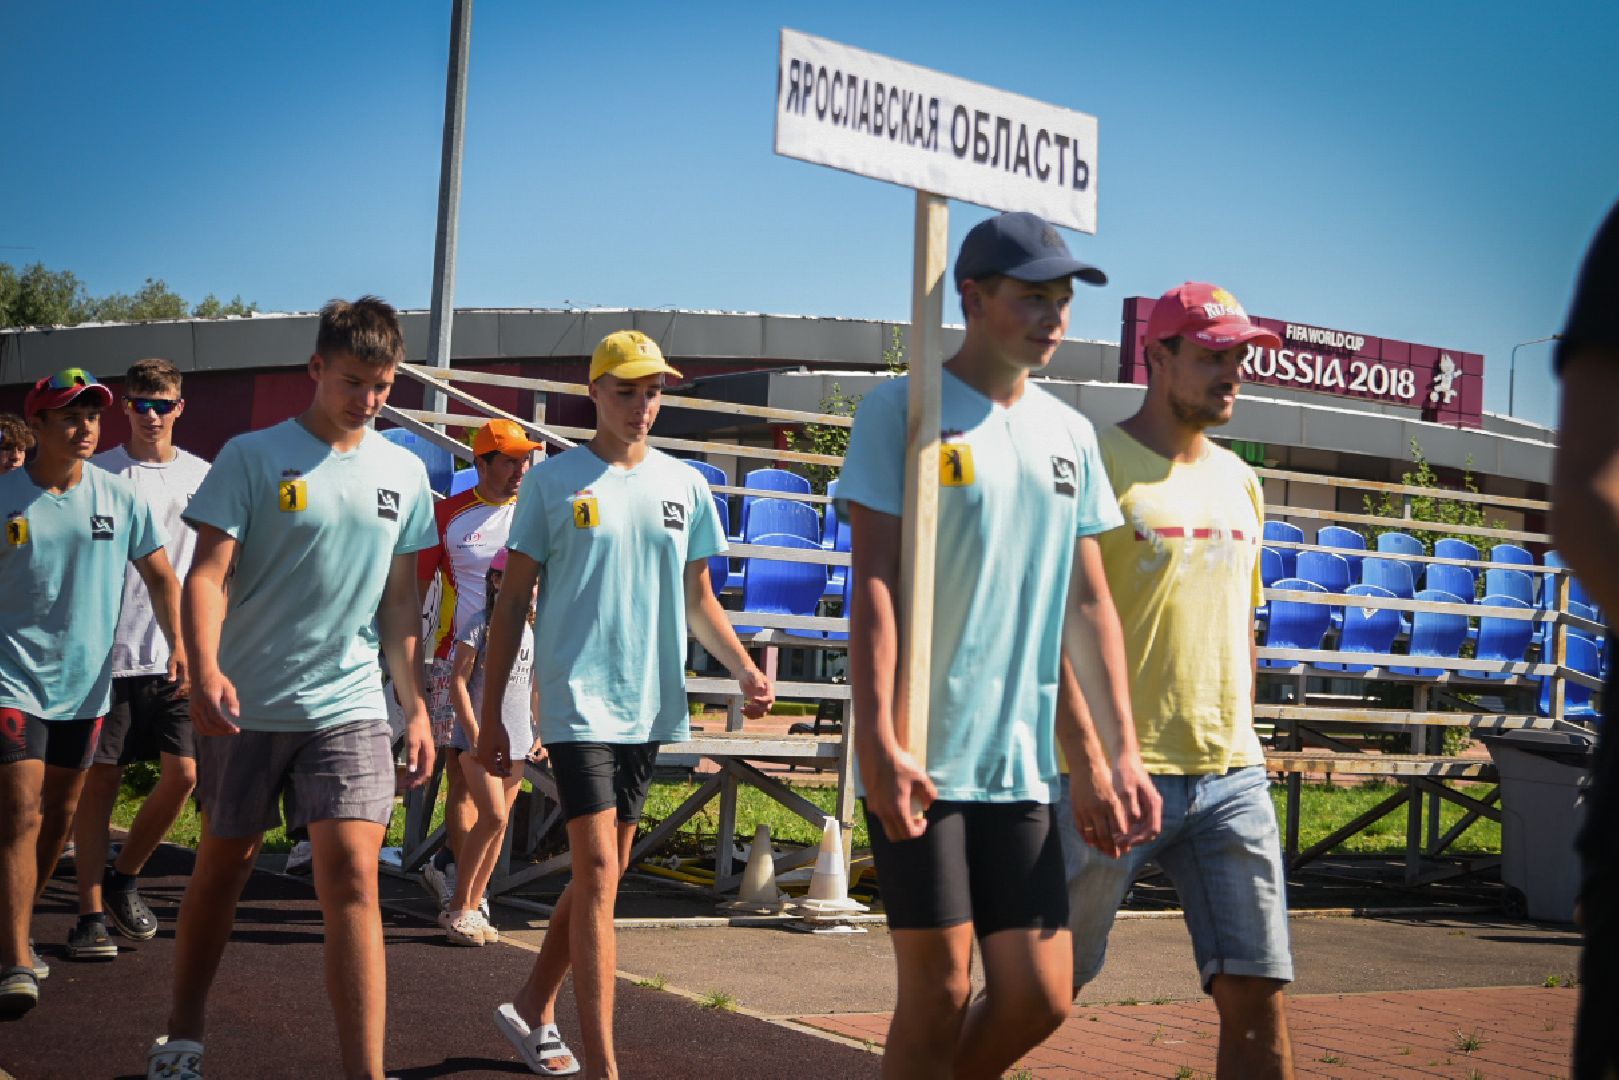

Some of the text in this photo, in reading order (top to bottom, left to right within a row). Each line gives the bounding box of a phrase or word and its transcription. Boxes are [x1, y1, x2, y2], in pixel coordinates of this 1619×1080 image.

[786, 58, 1090, 191] ЯРОСЛАВСКАЯ ОБЛАСТЬ
[1286, 323, 1365, 351] FIFA WORLD CUP
[1348, 361, 1415, 399] 2018
